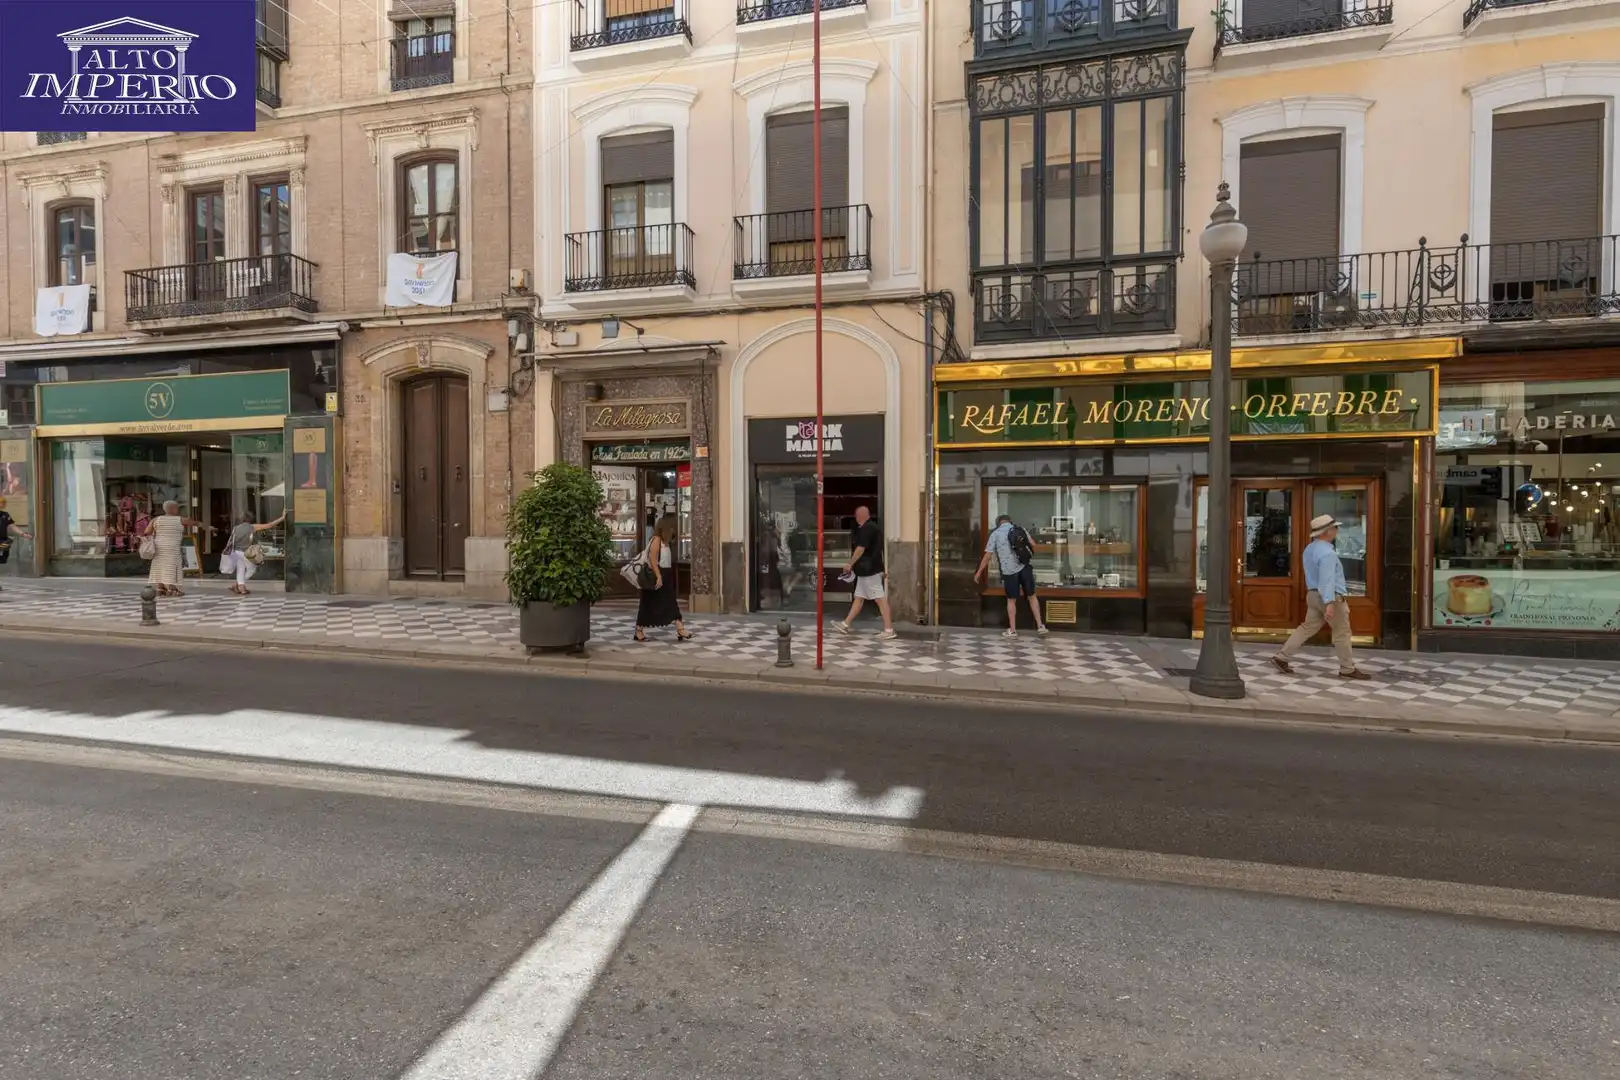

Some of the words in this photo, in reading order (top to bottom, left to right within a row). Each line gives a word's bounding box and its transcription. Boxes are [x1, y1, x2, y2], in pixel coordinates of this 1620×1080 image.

[613, 406, 681, 429] Milagrosa
[961, 402, 1069, 434] RAFAEL
[1243, 389, 1403, 419] ORFEBRE
[650, 450, 661, 460] en
[663, 446, 686, 460] 1925
